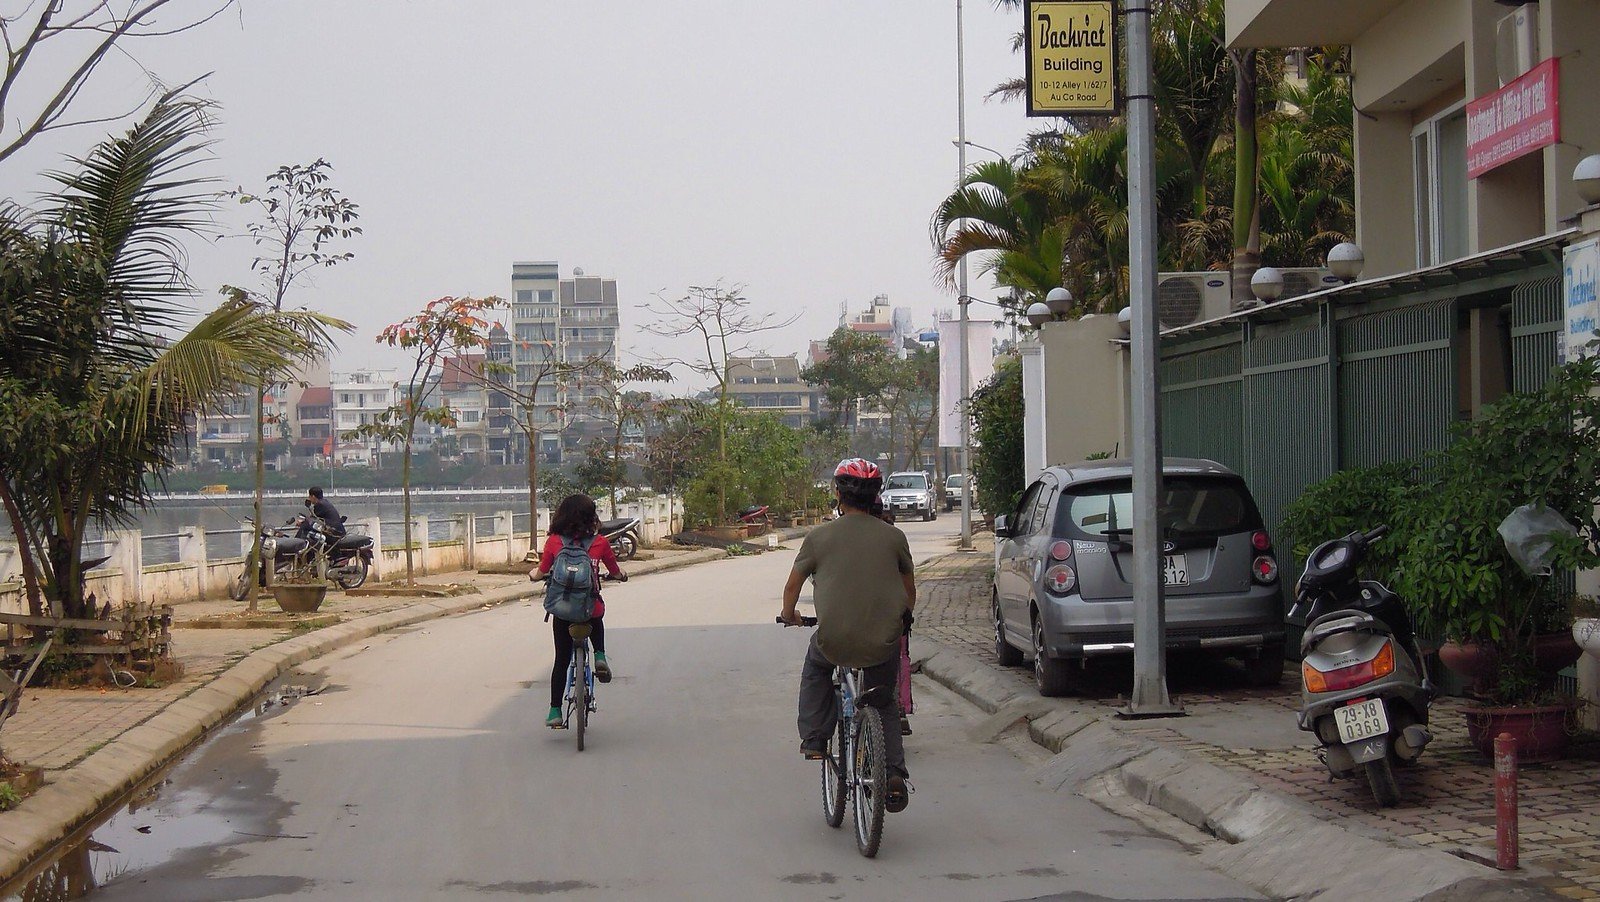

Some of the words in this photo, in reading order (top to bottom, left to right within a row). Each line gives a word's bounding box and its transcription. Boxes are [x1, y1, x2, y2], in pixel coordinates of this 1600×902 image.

[1044, 58, 1102, 73] Building
[1040, 81, 1060, 89] 10-12
[1062, 81, 1081, 90] Alley
[1084, 81, 1107, 90] 1/62/7
[1497, 97, 1502, 133] &
[1503, 90, 1522, 130] Office
[1521, 83, 1531, 120] for
[1533, 73, 1546, 115] rent
[1342, 703, 1377, 724] 29-X8
[1346, 719, 1382, 739] 0369
